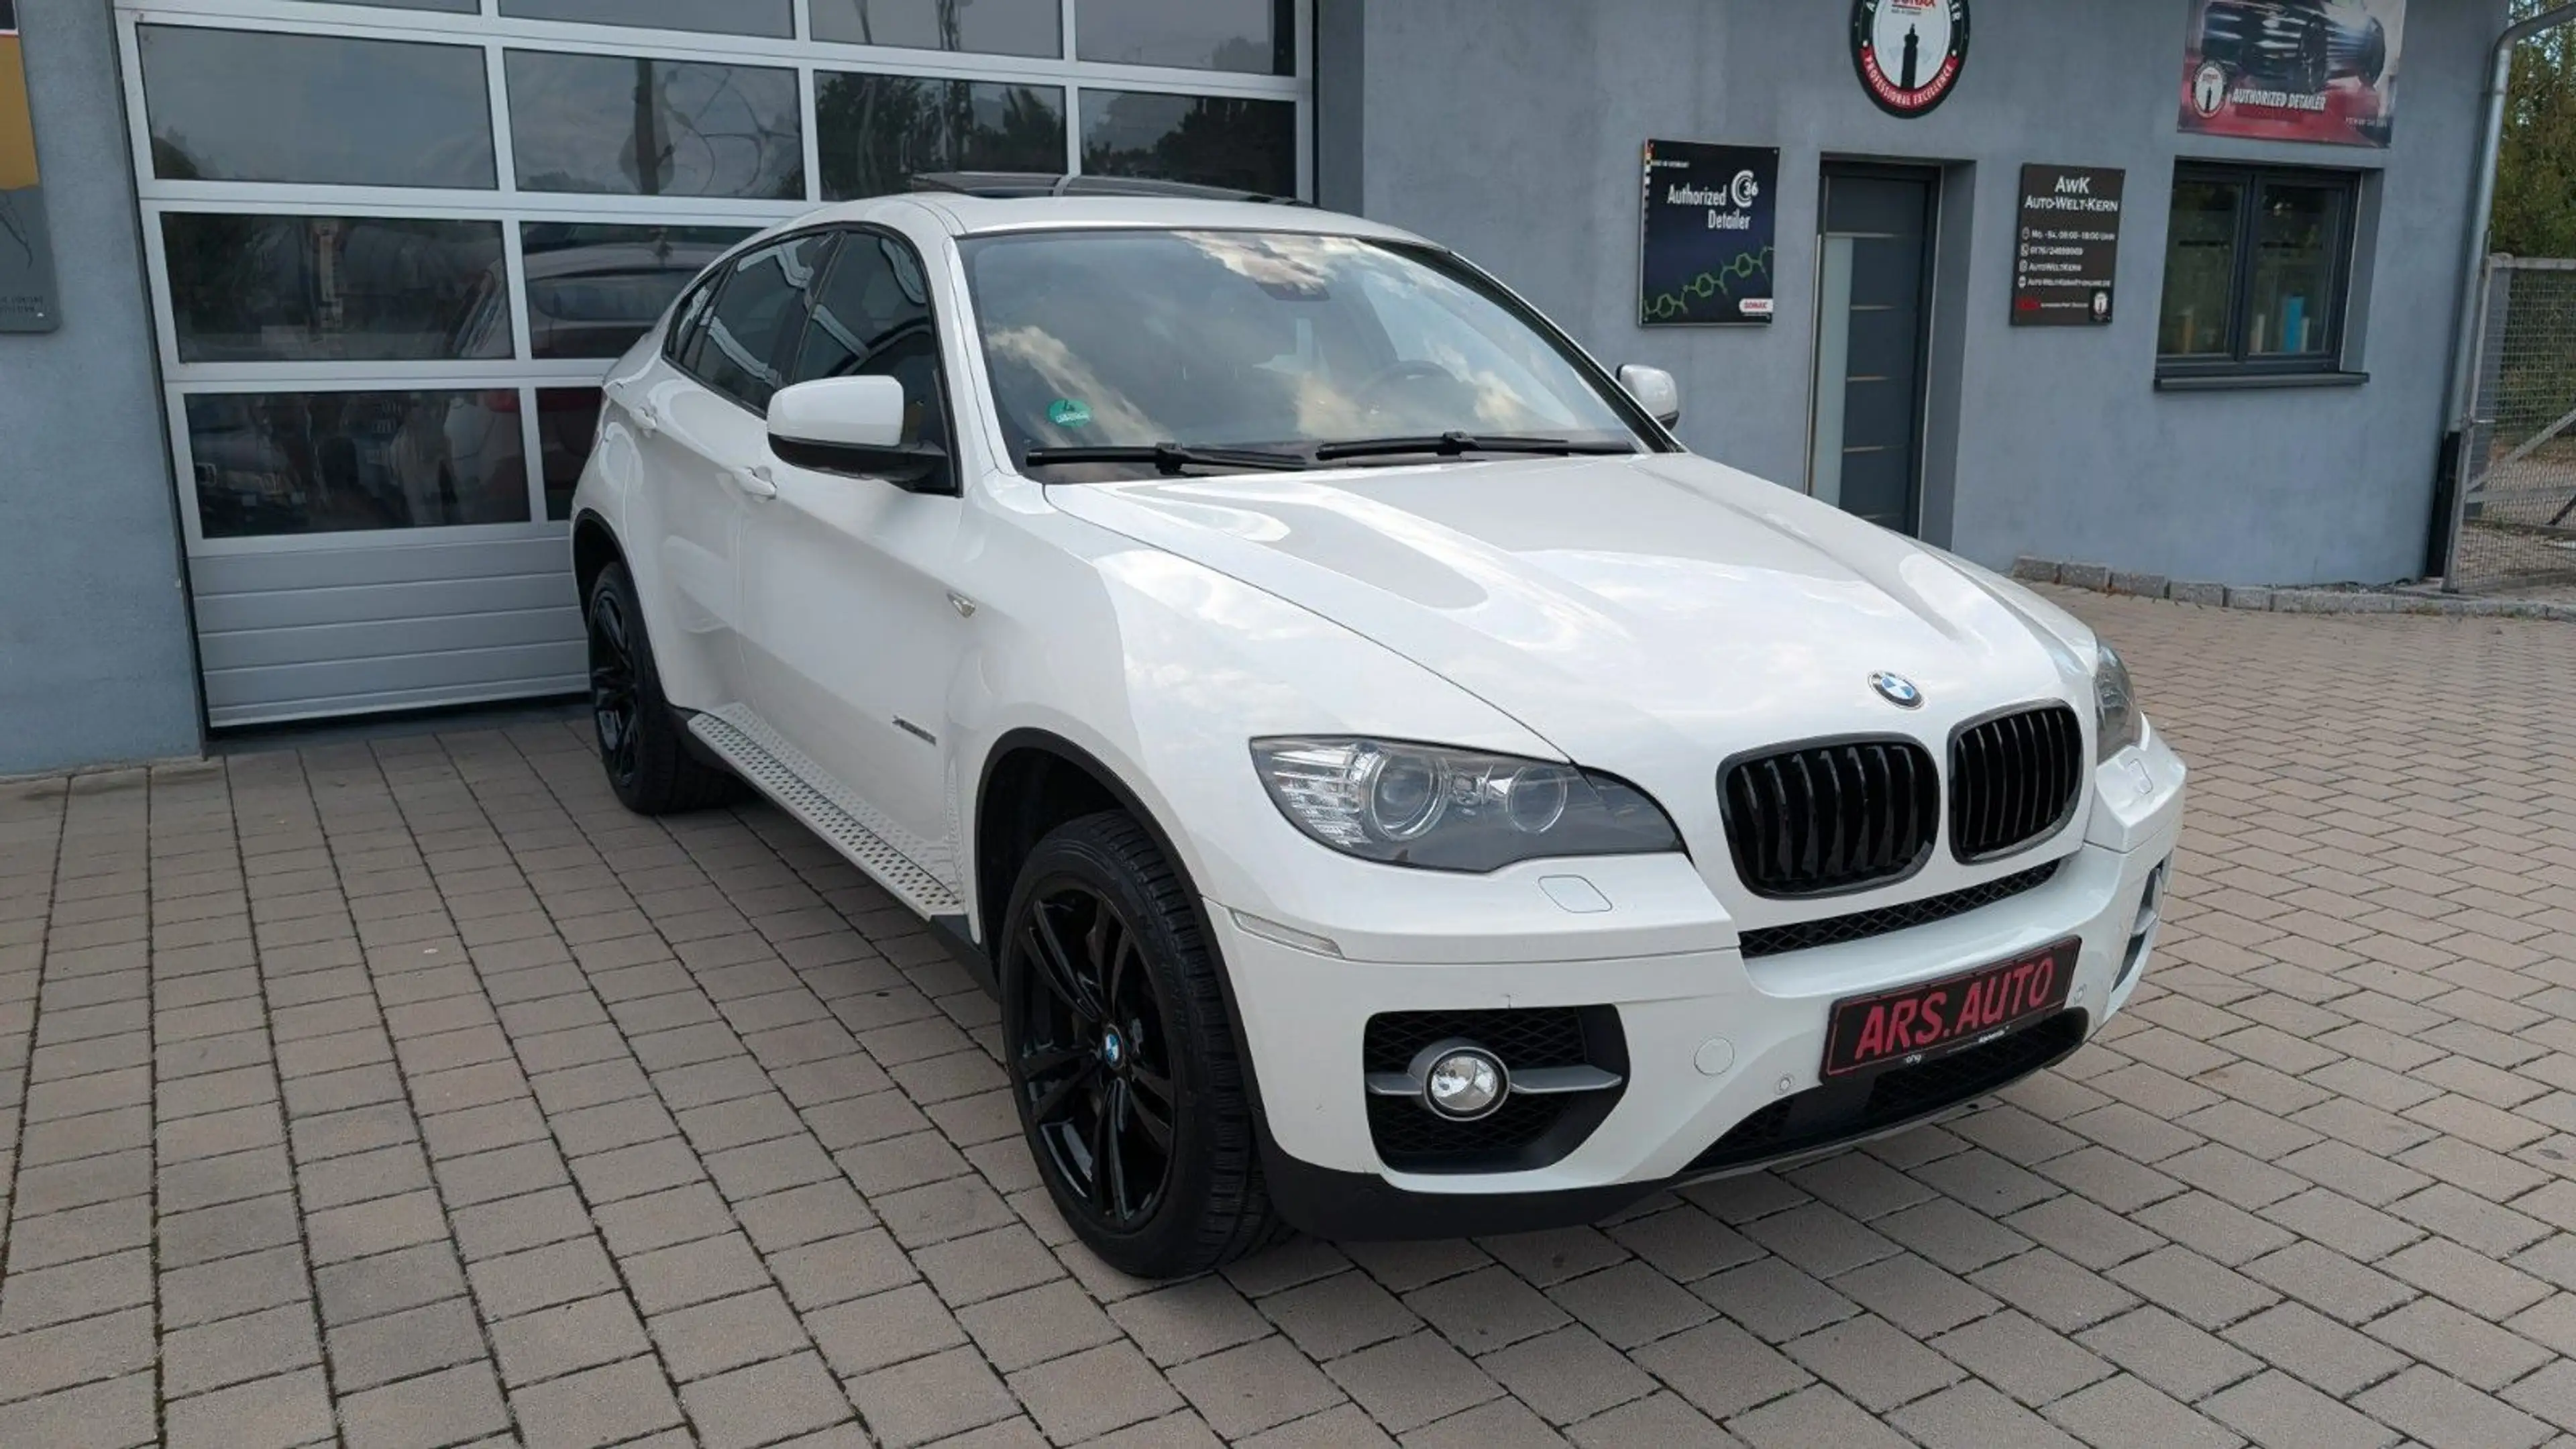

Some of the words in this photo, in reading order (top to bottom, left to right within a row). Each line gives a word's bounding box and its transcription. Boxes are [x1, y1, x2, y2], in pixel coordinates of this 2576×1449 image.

[1862, 56, 1912, 106] PROFESSIONAL
[1913, 64, 1954, 106] EXCELLENCE
[2232, 88, 2287, 107] AUTHORIZED
[2288, 93, 2326, 111] DETAILER
[1666, 182, 1727, 207] Authorized
[1707, 209, 1752, 230] Detailer
